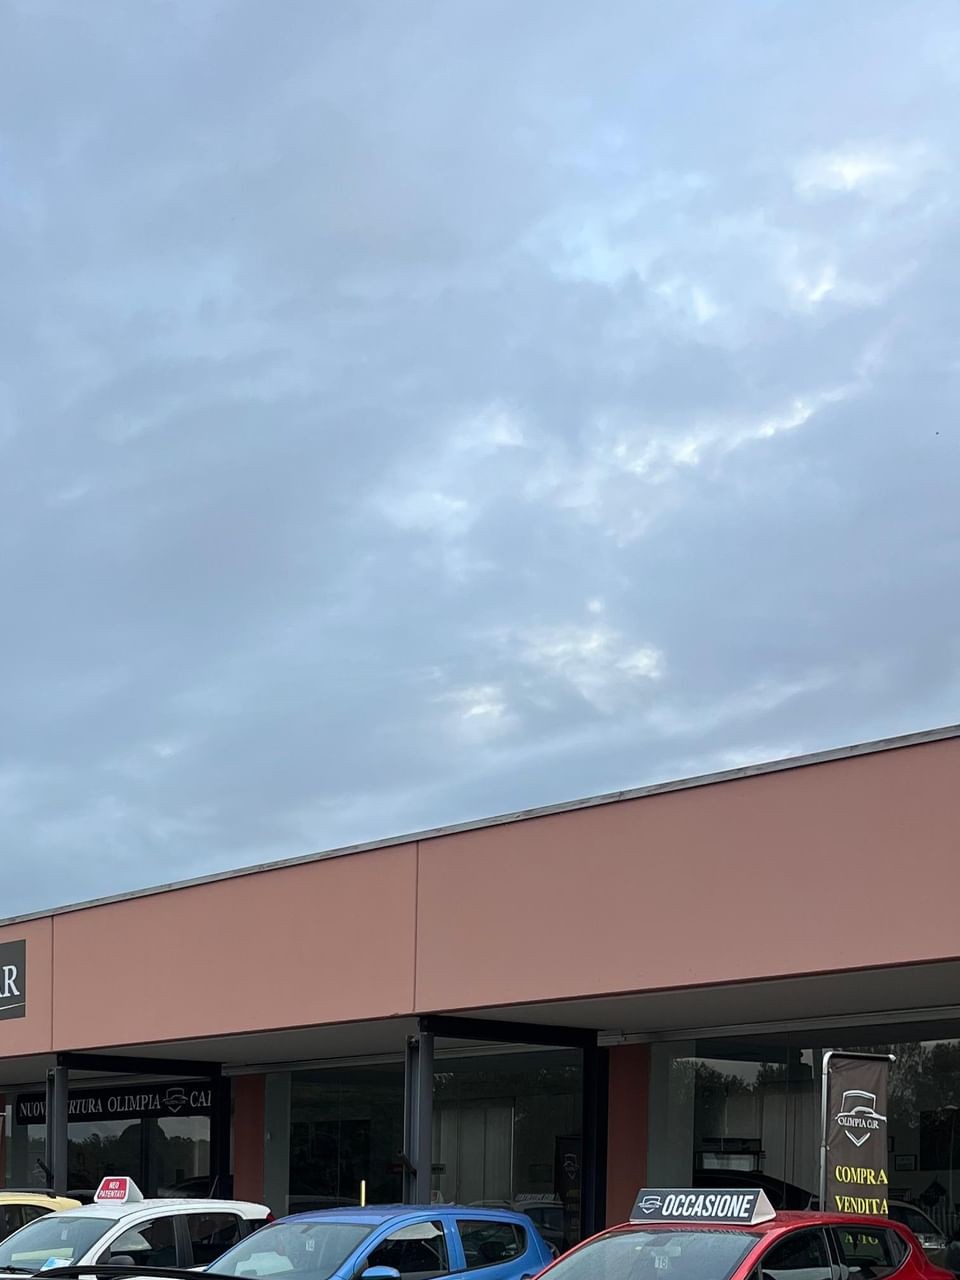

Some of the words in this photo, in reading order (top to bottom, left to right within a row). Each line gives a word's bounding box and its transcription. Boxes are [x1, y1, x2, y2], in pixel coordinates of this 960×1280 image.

[107, 1094, 161, 1113] OLIMPIA
[835, 1165, 888, 1185] COMPRA
[662, 1194, 754, 1218] OCCASIONE
[835, 1195, 888, 1214] VENDITA
